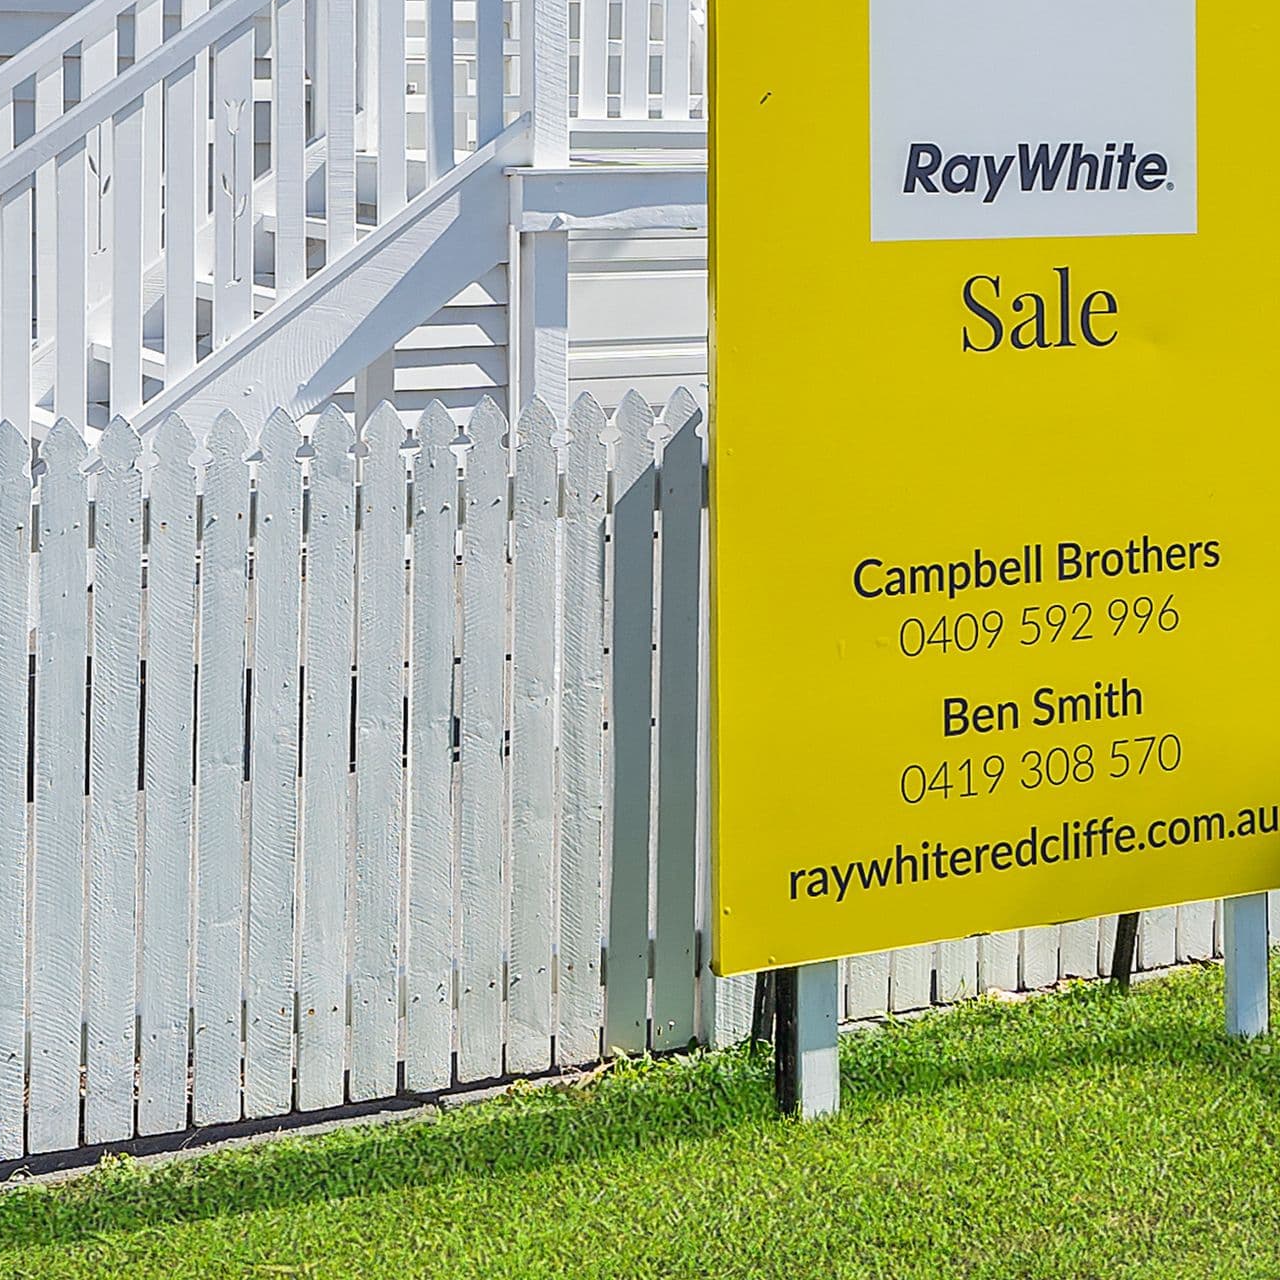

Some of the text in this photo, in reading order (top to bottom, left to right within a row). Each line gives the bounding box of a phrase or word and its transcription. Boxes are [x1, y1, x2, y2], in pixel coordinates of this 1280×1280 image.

[962, 266, 1118, 352] Sale
[853, 535, 1220, 599] Campbell Brothers
[900, 594, 1179, 657] 0409 592 996
[943, 677, 1142, 737] Ben Smith
[901, 734, 1181, 804] 0419 308 570
[789, 805, 1279, 902] raywhiteredcliffe.com.au
